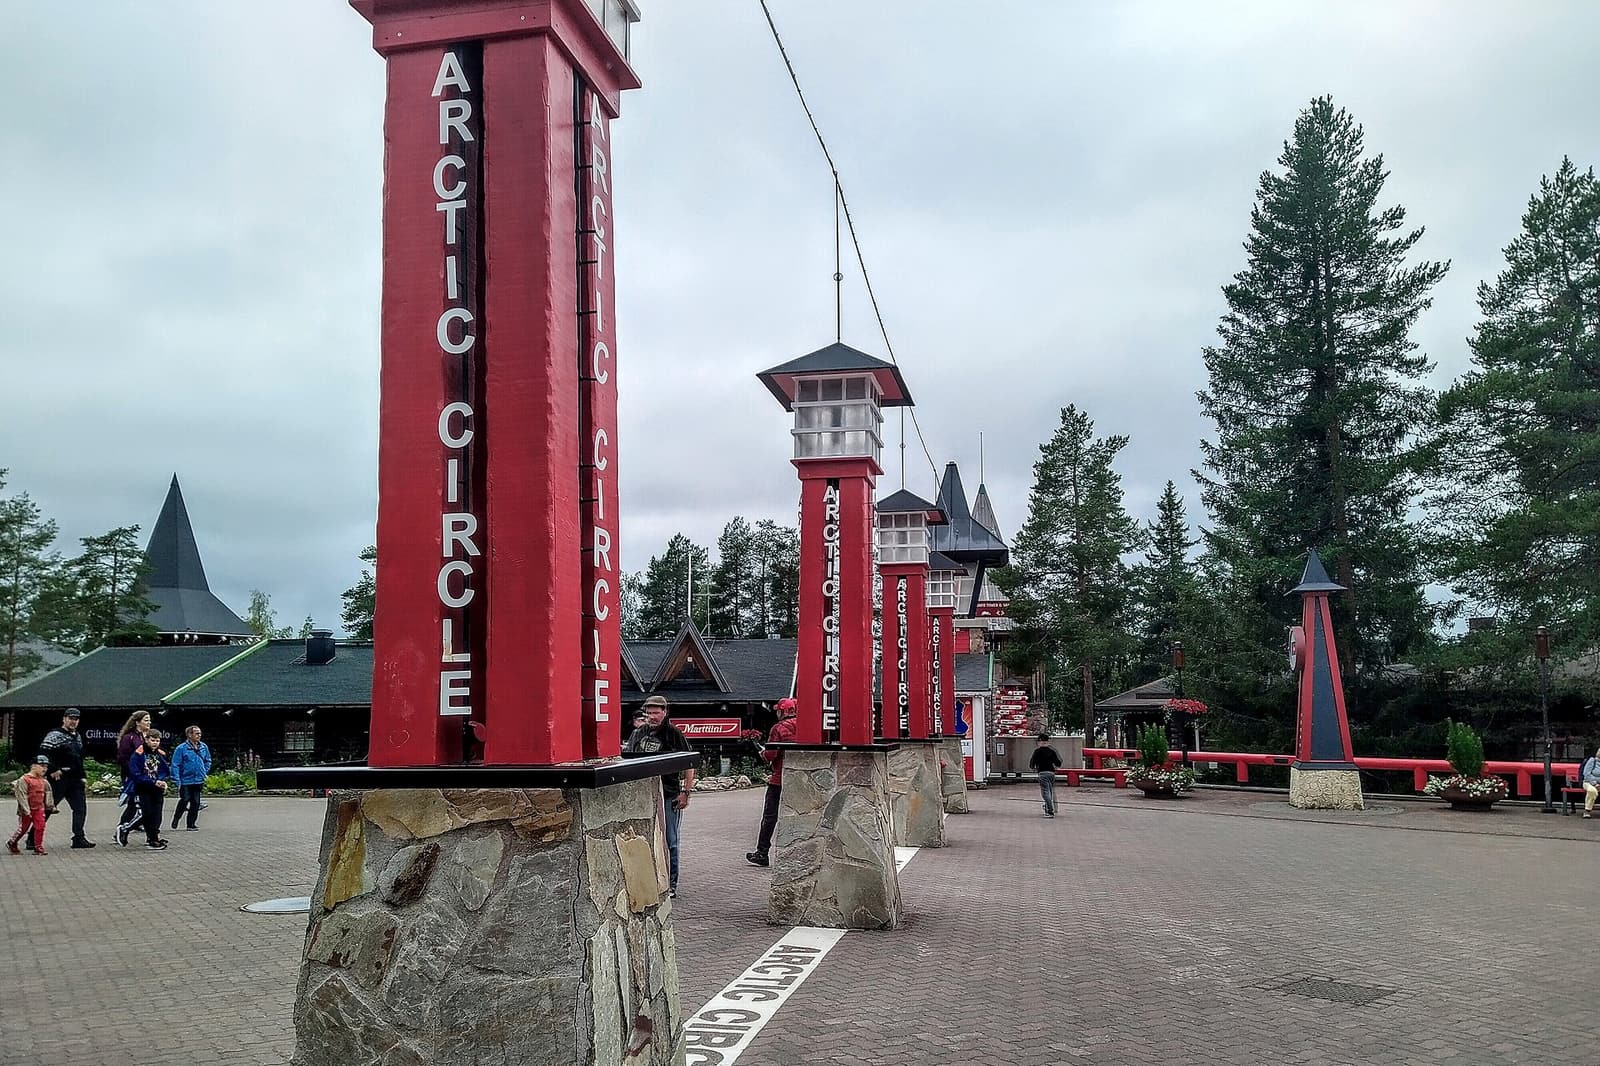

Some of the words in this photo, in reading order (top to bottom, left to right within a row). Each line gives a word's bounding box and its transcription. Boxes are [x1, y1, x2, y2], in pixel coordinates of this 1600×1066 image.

[431, 52, 475, 355] ARCTIC
[590, 95, 609, 385] ARCTIC
[437, 402, 481, 716] CIRCLE
[593, 428, 612, 722] CIRCLE
[822, 485, 840, 597] ARCTIC
[896, 578, 908, 649] ARCTIC
[932, 617, 940, 669] ARCTIC
[822, 615, 840, 731] CIRCLE
[897, 658, 908, 730] CIRCLE
[932, 676, 942, 733] CIRCLE
[85, 729, 102, 739] Gift
[103, 729, 120, 739] hou
[682, 722, 723, 734] Marttiini
[721, 944, 822, 1002] ARCTIC
